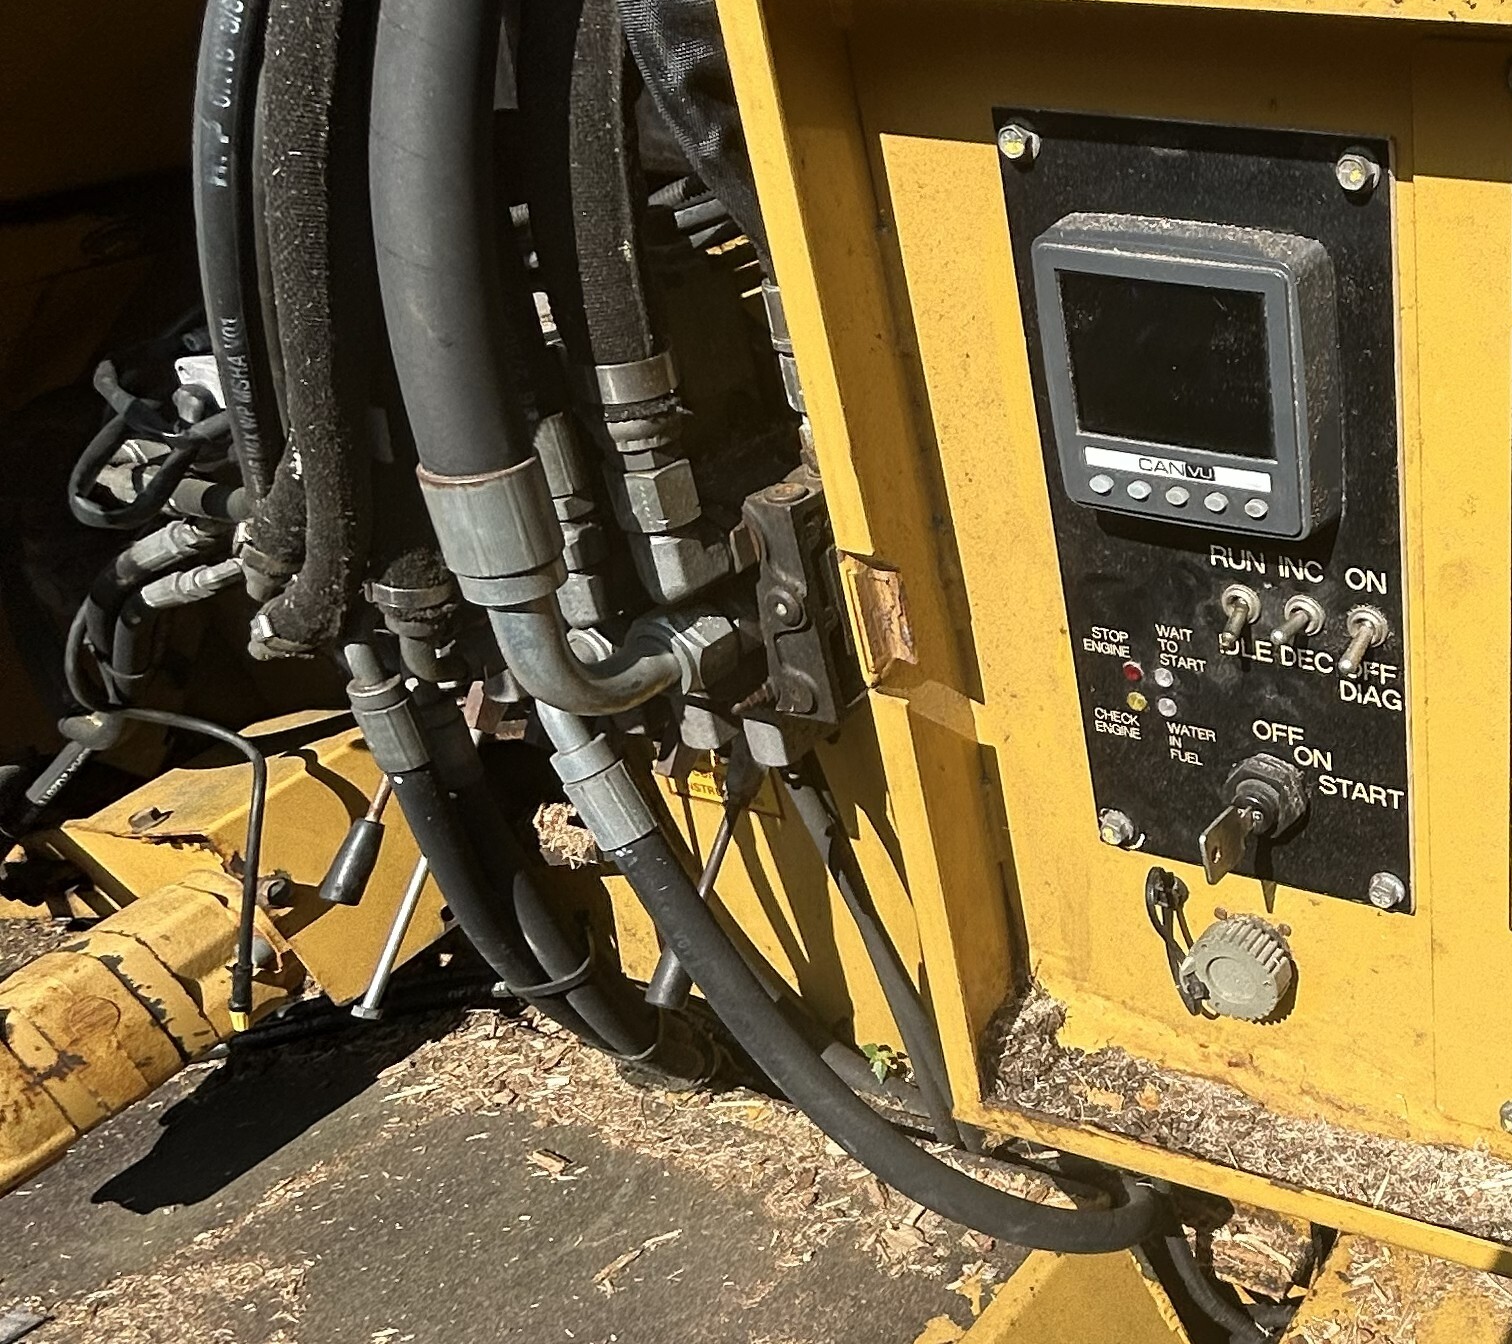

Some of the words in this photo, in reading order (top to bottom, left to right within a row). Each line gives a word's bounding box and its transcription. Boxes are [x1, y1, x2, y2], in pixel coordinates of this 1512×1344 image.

[1210, 544, 1266, 575] RUN
[1278, 555, 1324, 583] INC
[1345, 567, 1387, 595] ON
[1091, 626, 1129, 643] STOP
[1155, 623, 1193, 642] WAIT
[1083, 638, 1131, 658] ENGINE
[1157, 638, 1178, 653] TO
[1160, 654, 1206, 673] START
[1280, 644, 1334, 674] DEC
[1339, 679, 1403, 711] DIAG
[1094, 707, 1140, 727] CHECK
[1094, 720, 1142, 740] ENGINE
[1166, 721, 1217, 743] WATER
[1252, 719, 1304, 745] OFF
[1169, 735, 1182, 749] IN
[1170, 748, 1204, 766] FUEL
[1293, 745, 1332, 772] ON
[1318, 774, 1405, 810] START
